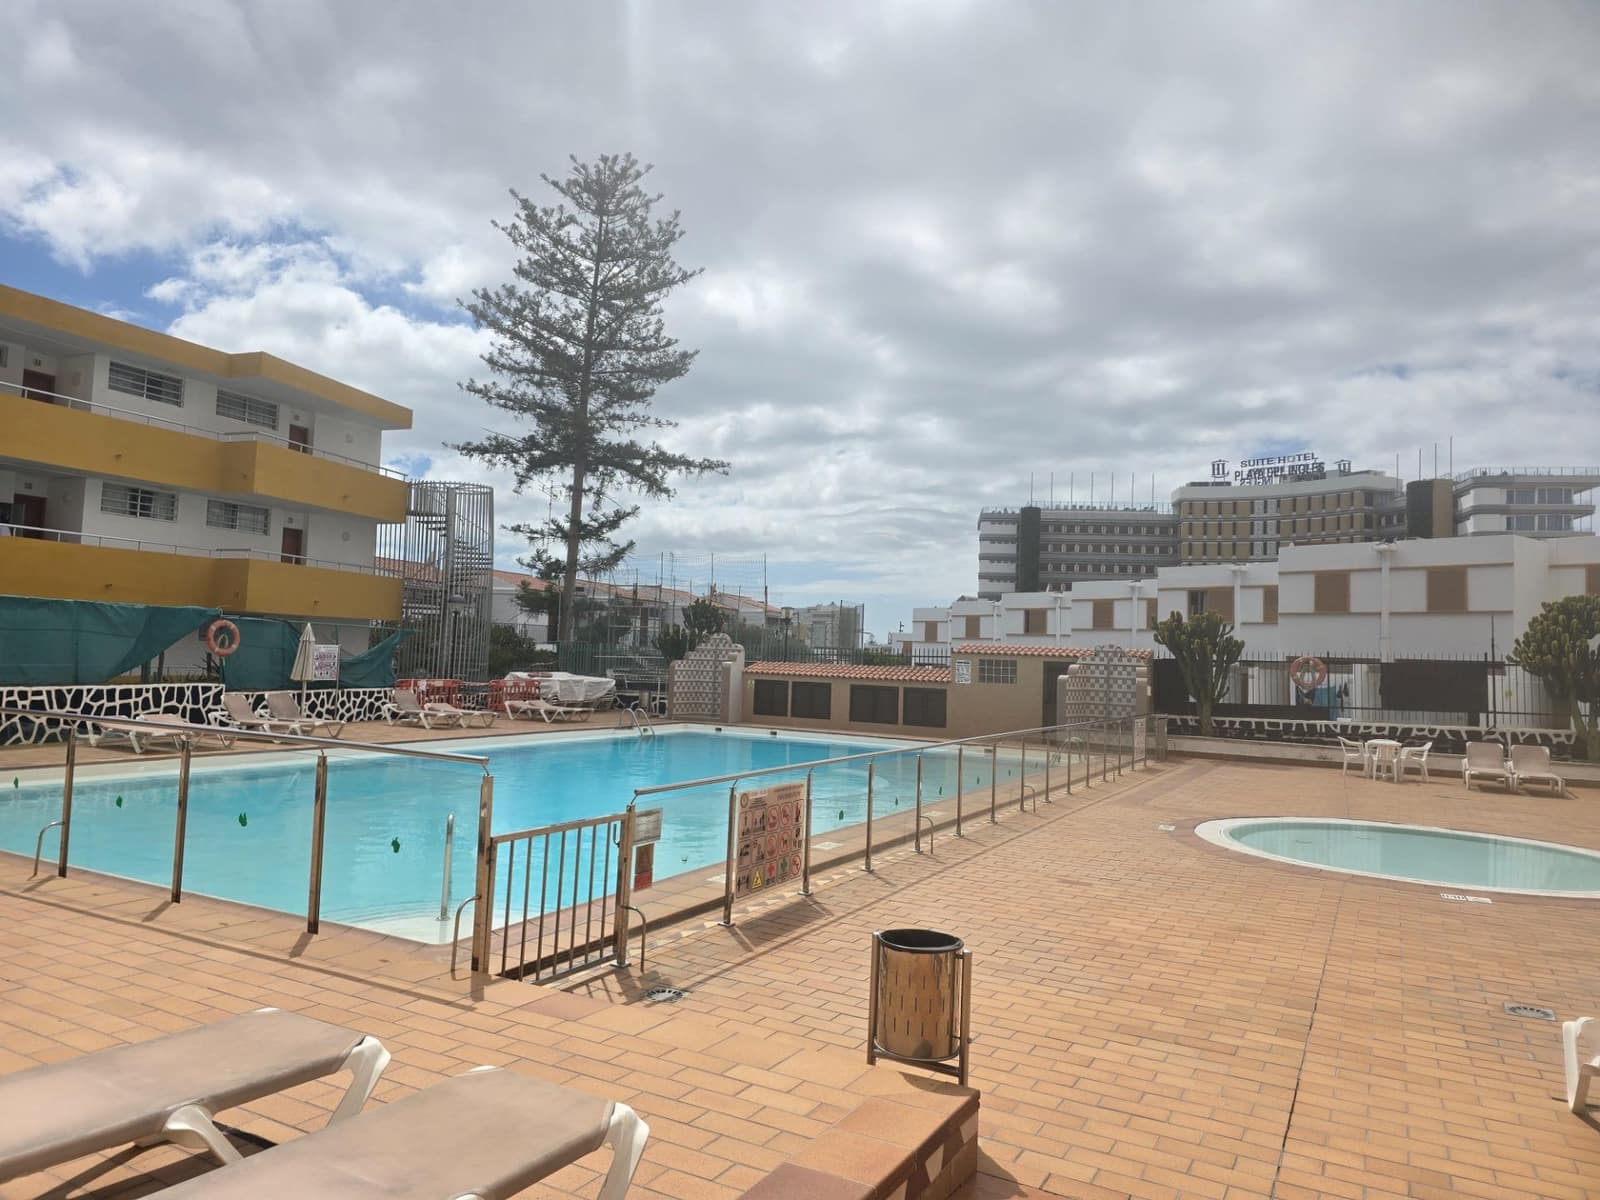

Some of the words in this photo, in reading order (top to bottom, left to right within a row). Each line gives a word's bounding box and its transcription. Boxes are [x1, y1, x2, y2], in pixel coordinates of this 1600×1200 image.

[1240, 458, 1274, 468] SUITE
[1278, 452, 1318, 464] HOTEL
[1235, 467, 1265, 481] PLAYA
